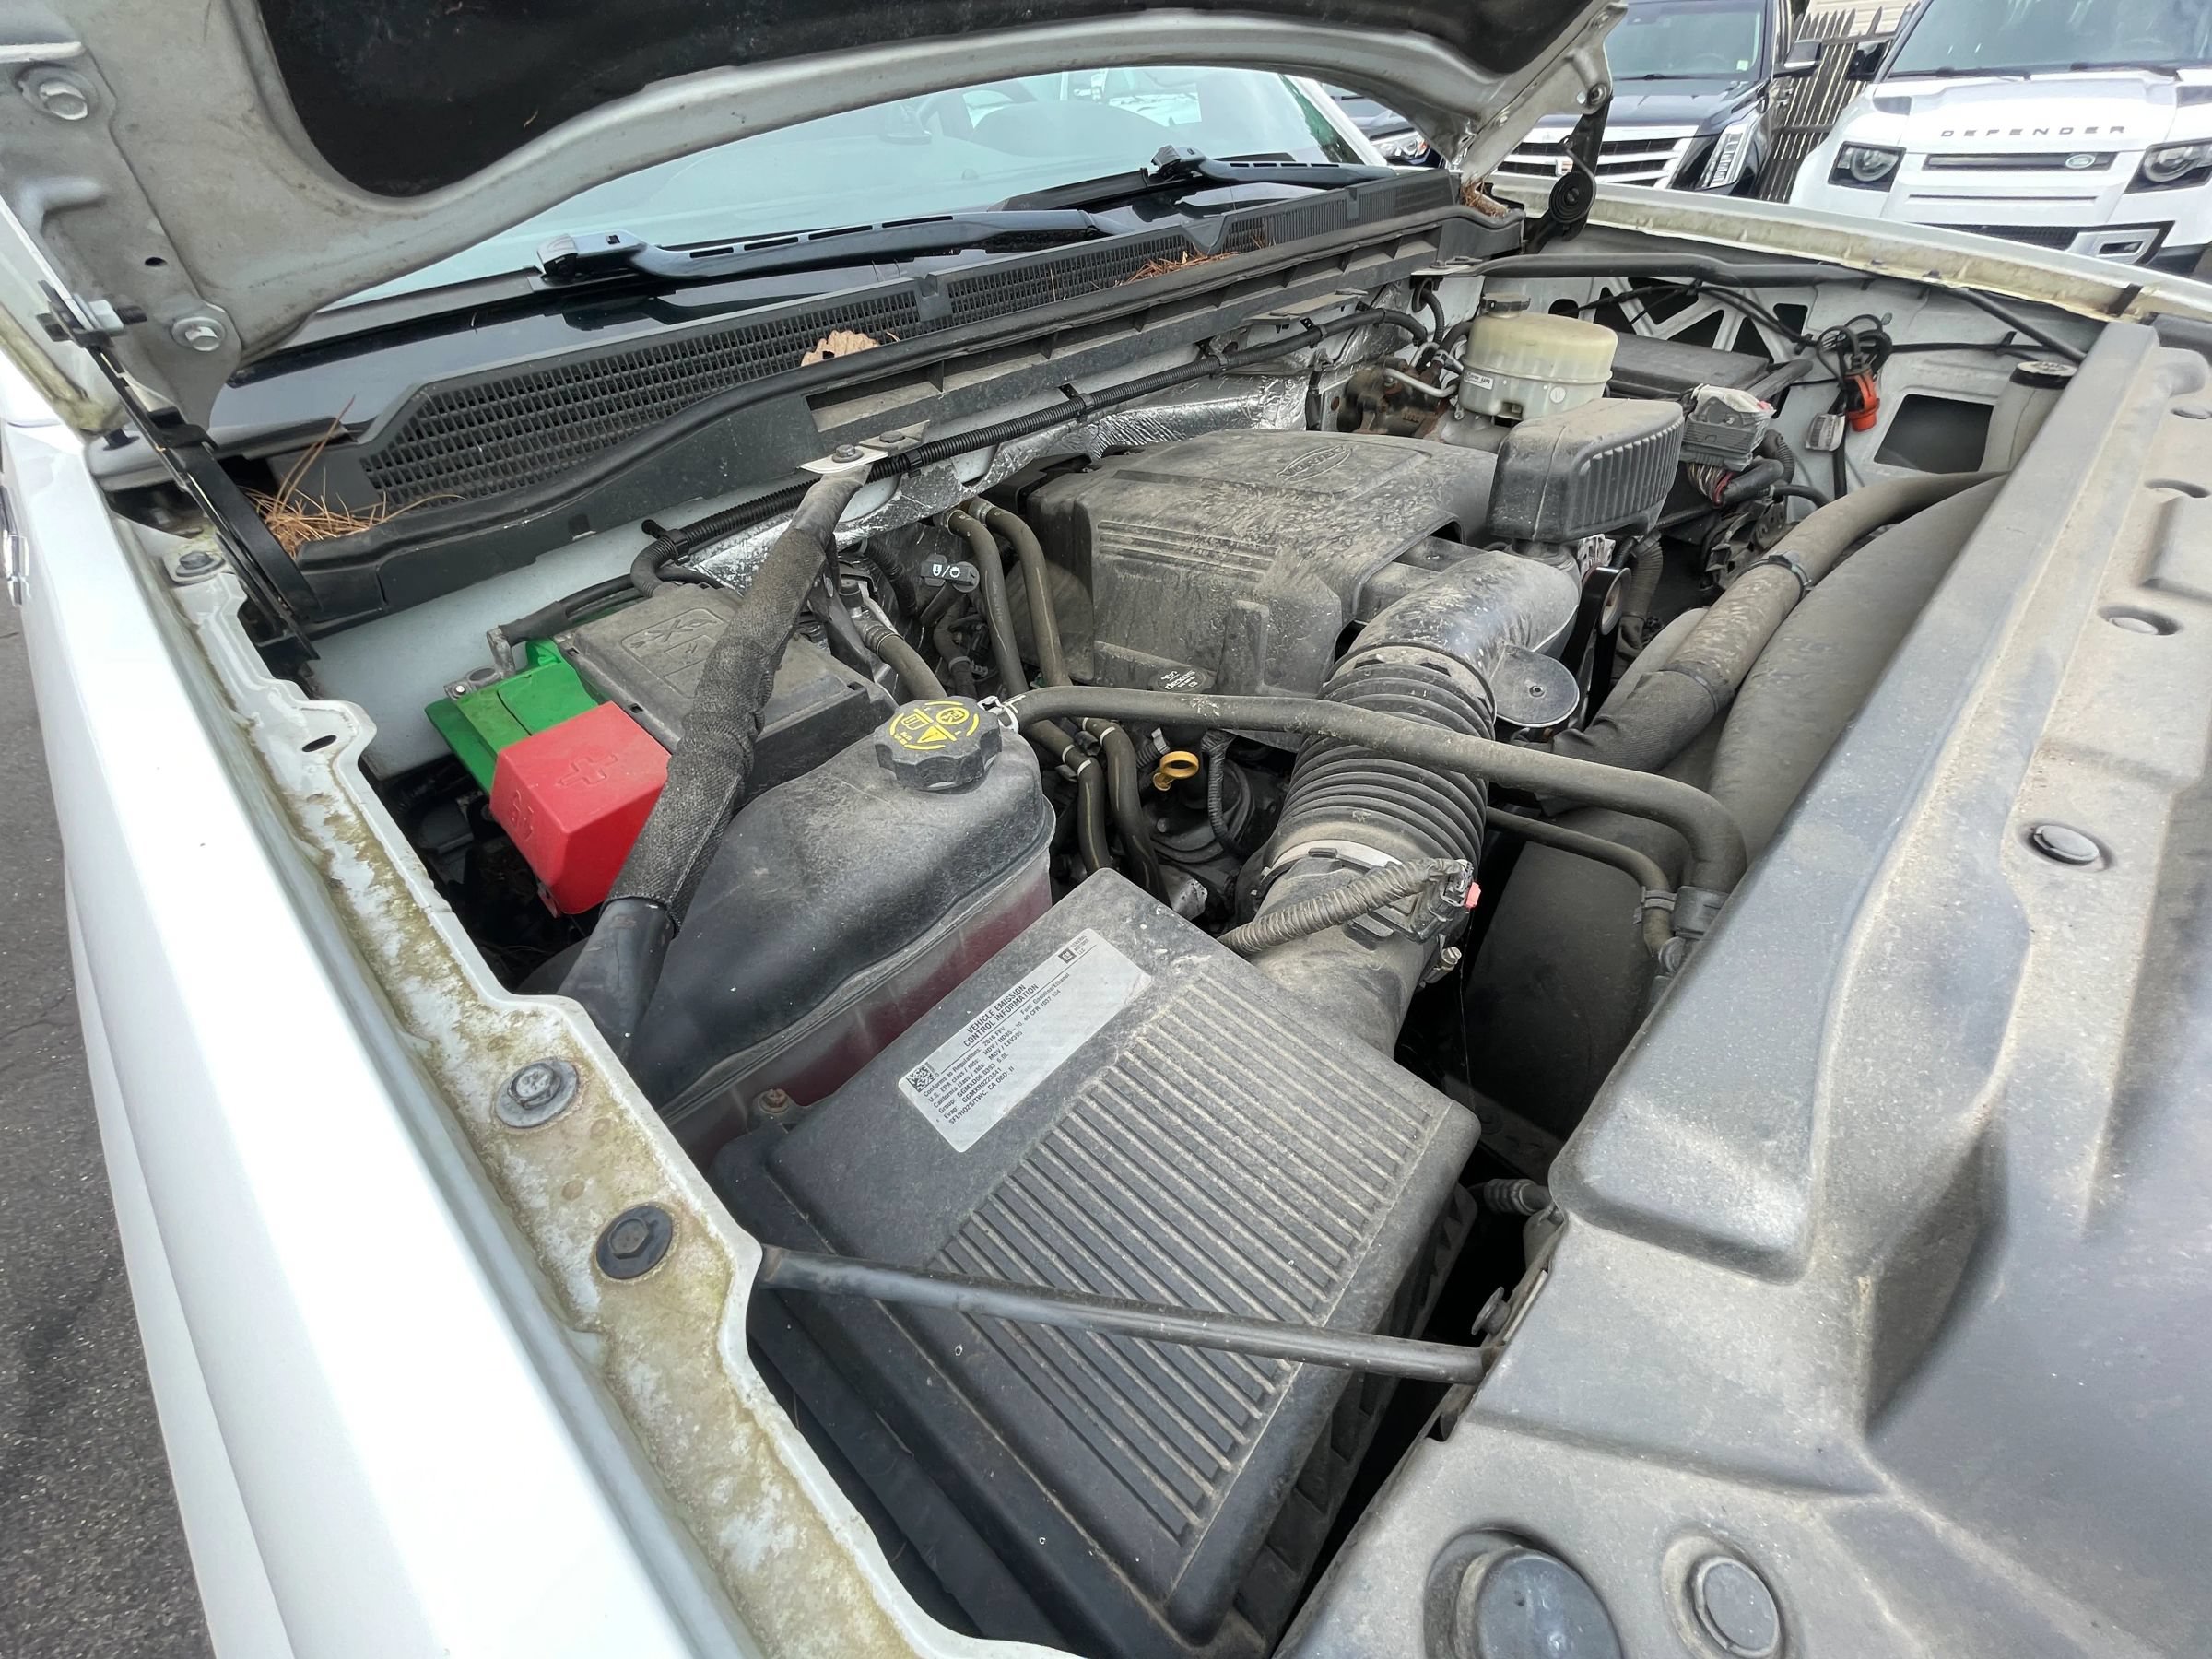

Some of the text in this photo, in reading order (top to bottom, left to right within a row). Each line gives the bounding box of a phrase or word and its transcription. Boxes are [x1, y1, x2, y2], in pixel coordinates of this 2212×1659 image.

[1940, 126, 2125, 137] DEFENDER
[961, 982, 1040, 1048] CONTROL INFORMATION
[965, 982, 1027, 1035] VEHICLE EMISSION
[922, 1075, 948, 1098] Conforms
[982, 1033, 996, 1047] 2016
[994, 1025, 1006, 1037] FFV
[938, 1080, 952, 1093] EPA
[949, 1069, 965, 1084] class
[982, 1041, 997, 1056] HDV
[1028, 1004, 1041, 1017] CFR
[931, 1084, 959, 1108] California
[955, 1073, 971, 1088] class
[986, 1046, 1003, 1061] MDV
[986, 1080, 997, 1091] CA
[936, 1096, 957, 1114] Group:
[942, 1103, 959, 1120] Evap:
